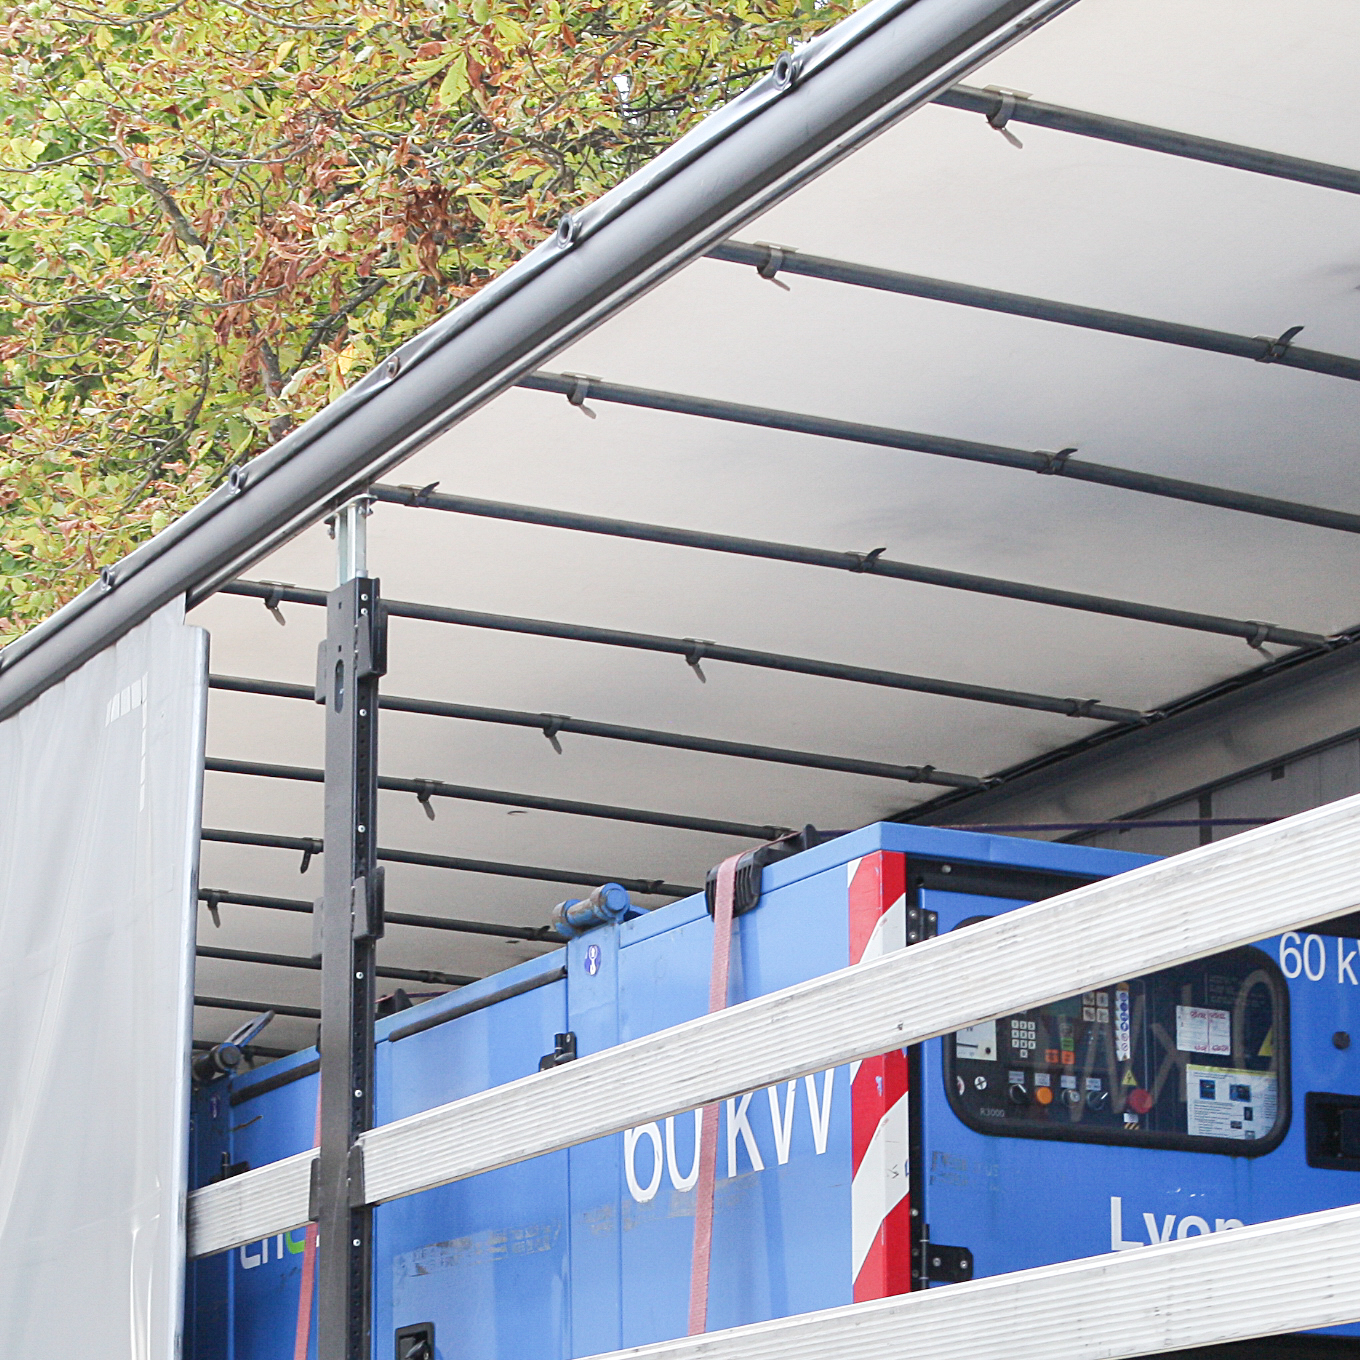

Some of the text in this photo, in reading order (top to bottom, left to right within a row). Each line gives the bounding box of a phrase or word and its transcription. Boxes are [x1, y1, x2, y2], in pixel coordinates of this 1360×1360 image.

[1280, 931, 1326, 982] 60
[624, 1107, 704, 1204] 60
[727, 1067, 835, 1179] kW
